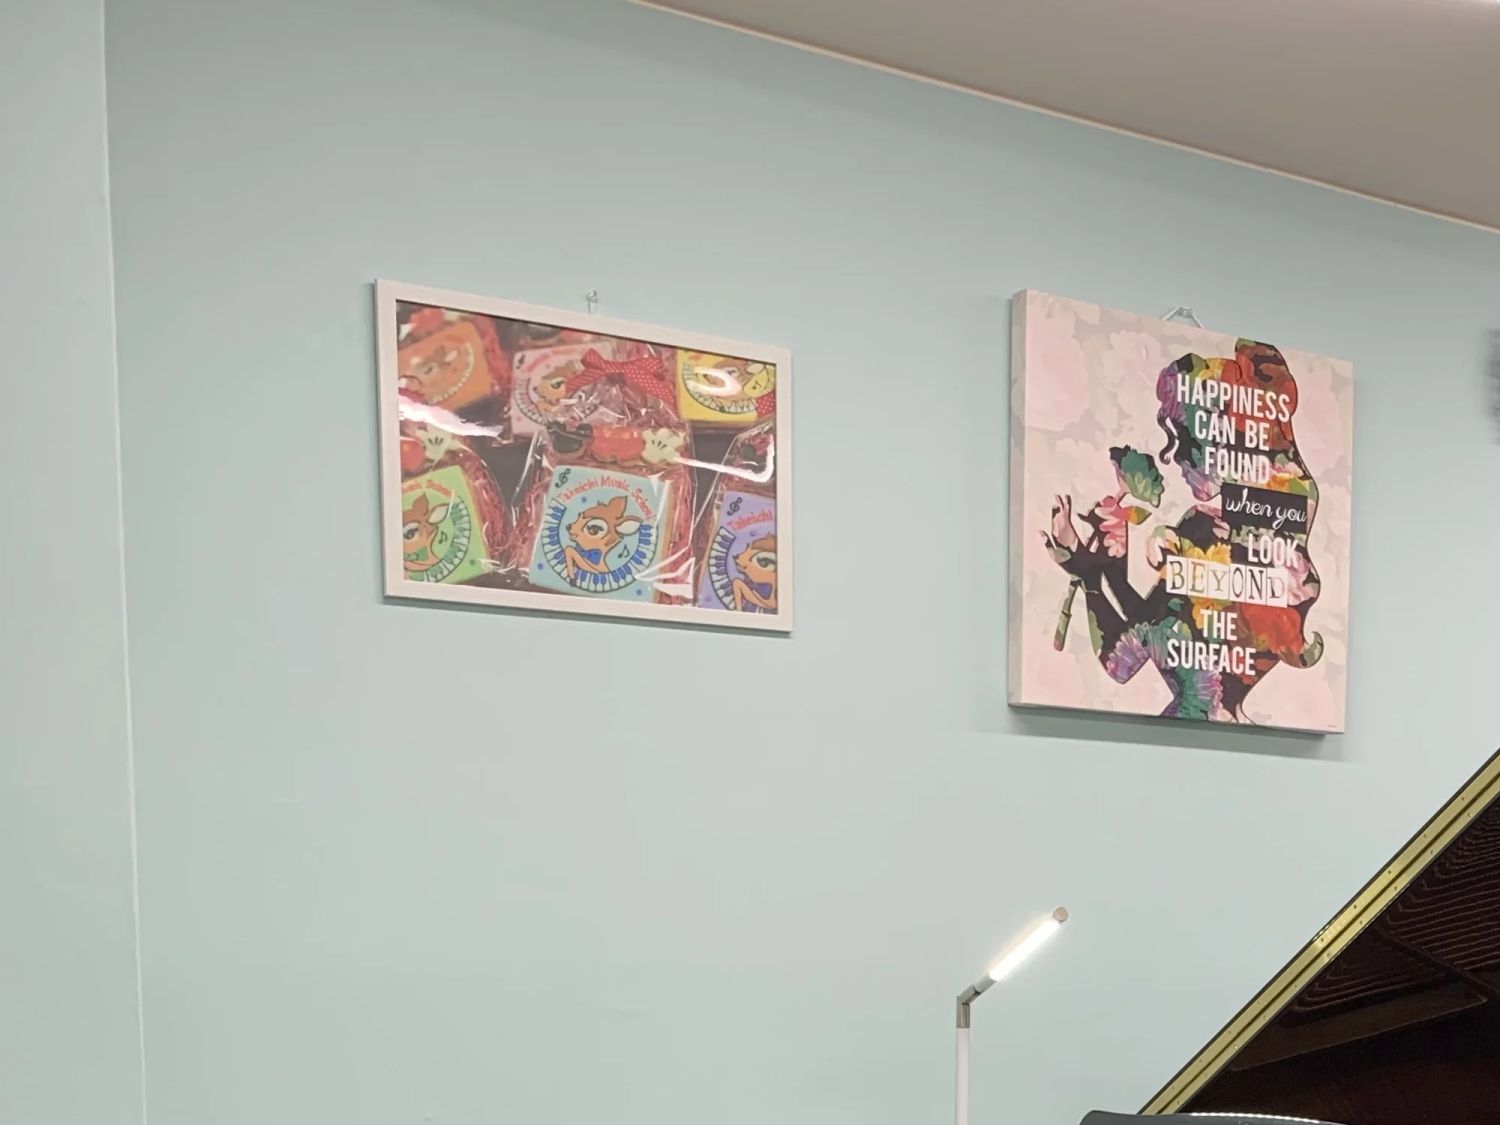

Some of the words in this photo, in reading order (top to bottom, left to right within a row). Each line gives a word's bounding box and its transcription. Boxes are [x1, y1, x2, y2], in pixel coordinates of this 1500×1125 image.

[1177, 373, 1290, 423] HAPPINESS
[1194, 410, 1236, 446] CAN
[1244, 419, 1270, 451] BE
[601, 475, 630, 491] Music
[1205, 446, 1270, 485] FOUND
[1225, 489, 1272, 517] when
[1275, 507, 1307, 528] you
[1247, 534, 1299, 567] LOOK
[1168, 557, 1287, 604] BEYOND
[1200, 609, 1238, 641] THE
[1167, 641, 1256, 676] SURFACE
